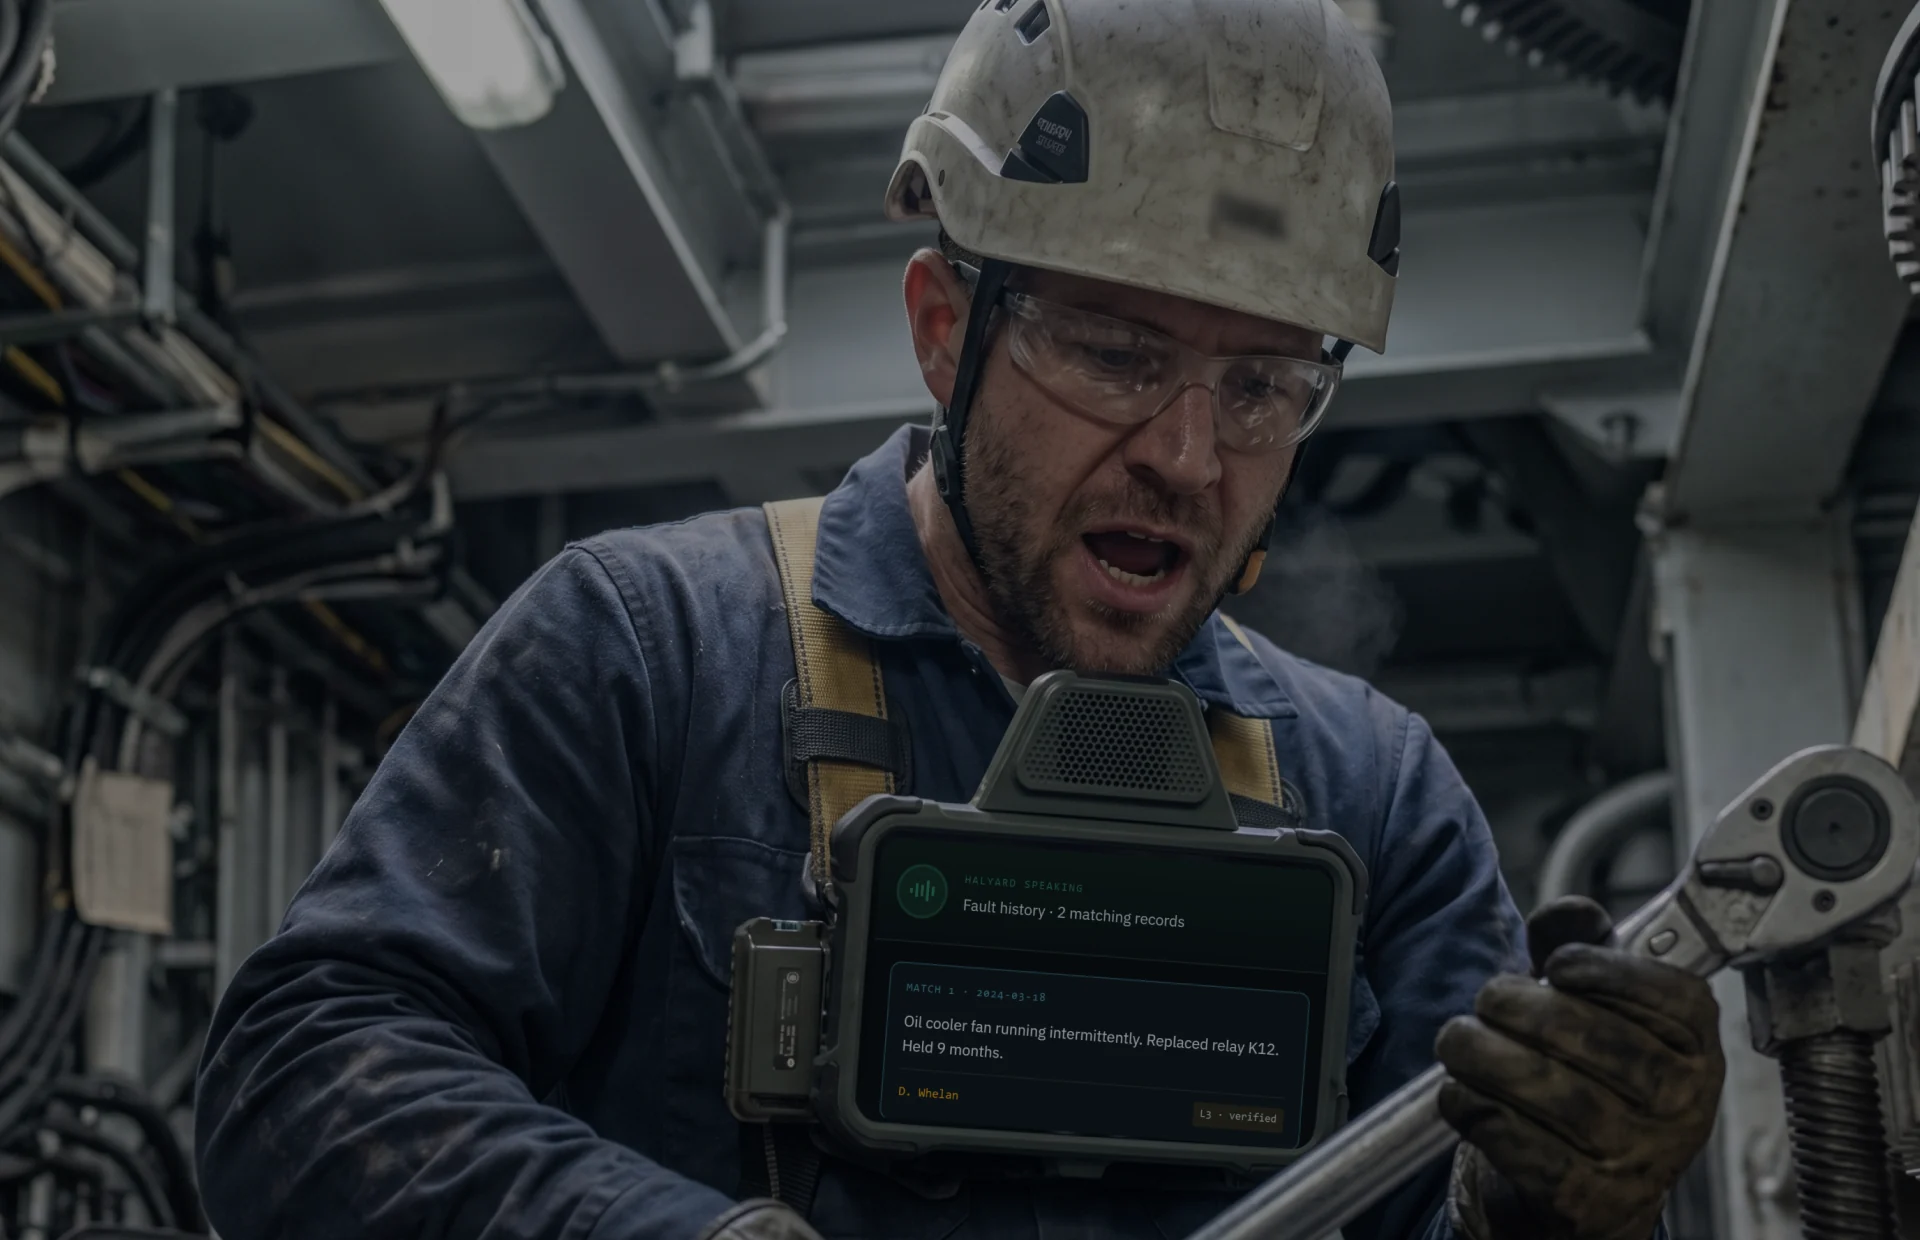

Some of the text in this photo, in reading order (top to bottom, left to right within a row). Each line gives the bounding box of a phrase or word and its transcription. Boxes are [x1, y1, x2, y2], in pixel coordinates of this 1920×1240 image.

[964, 874, 1083, 893] HALYARD SPEAKING
[963, 898, 1185, 928] Fault history 2 matching records
[906, 983, 942, 994] MATCH
[976, 989, 1046, 1002] 2024-03-18
[904, 1014, 1279, 1057] Oil cooler fan running intermittently. Replaced relay K12.
[902, 1039, 1004, 1060] Held 9 months.
[898, 1086, 959, 1100] D. Whelan
[1199, 1109, 1277, 1124] L3 verified
